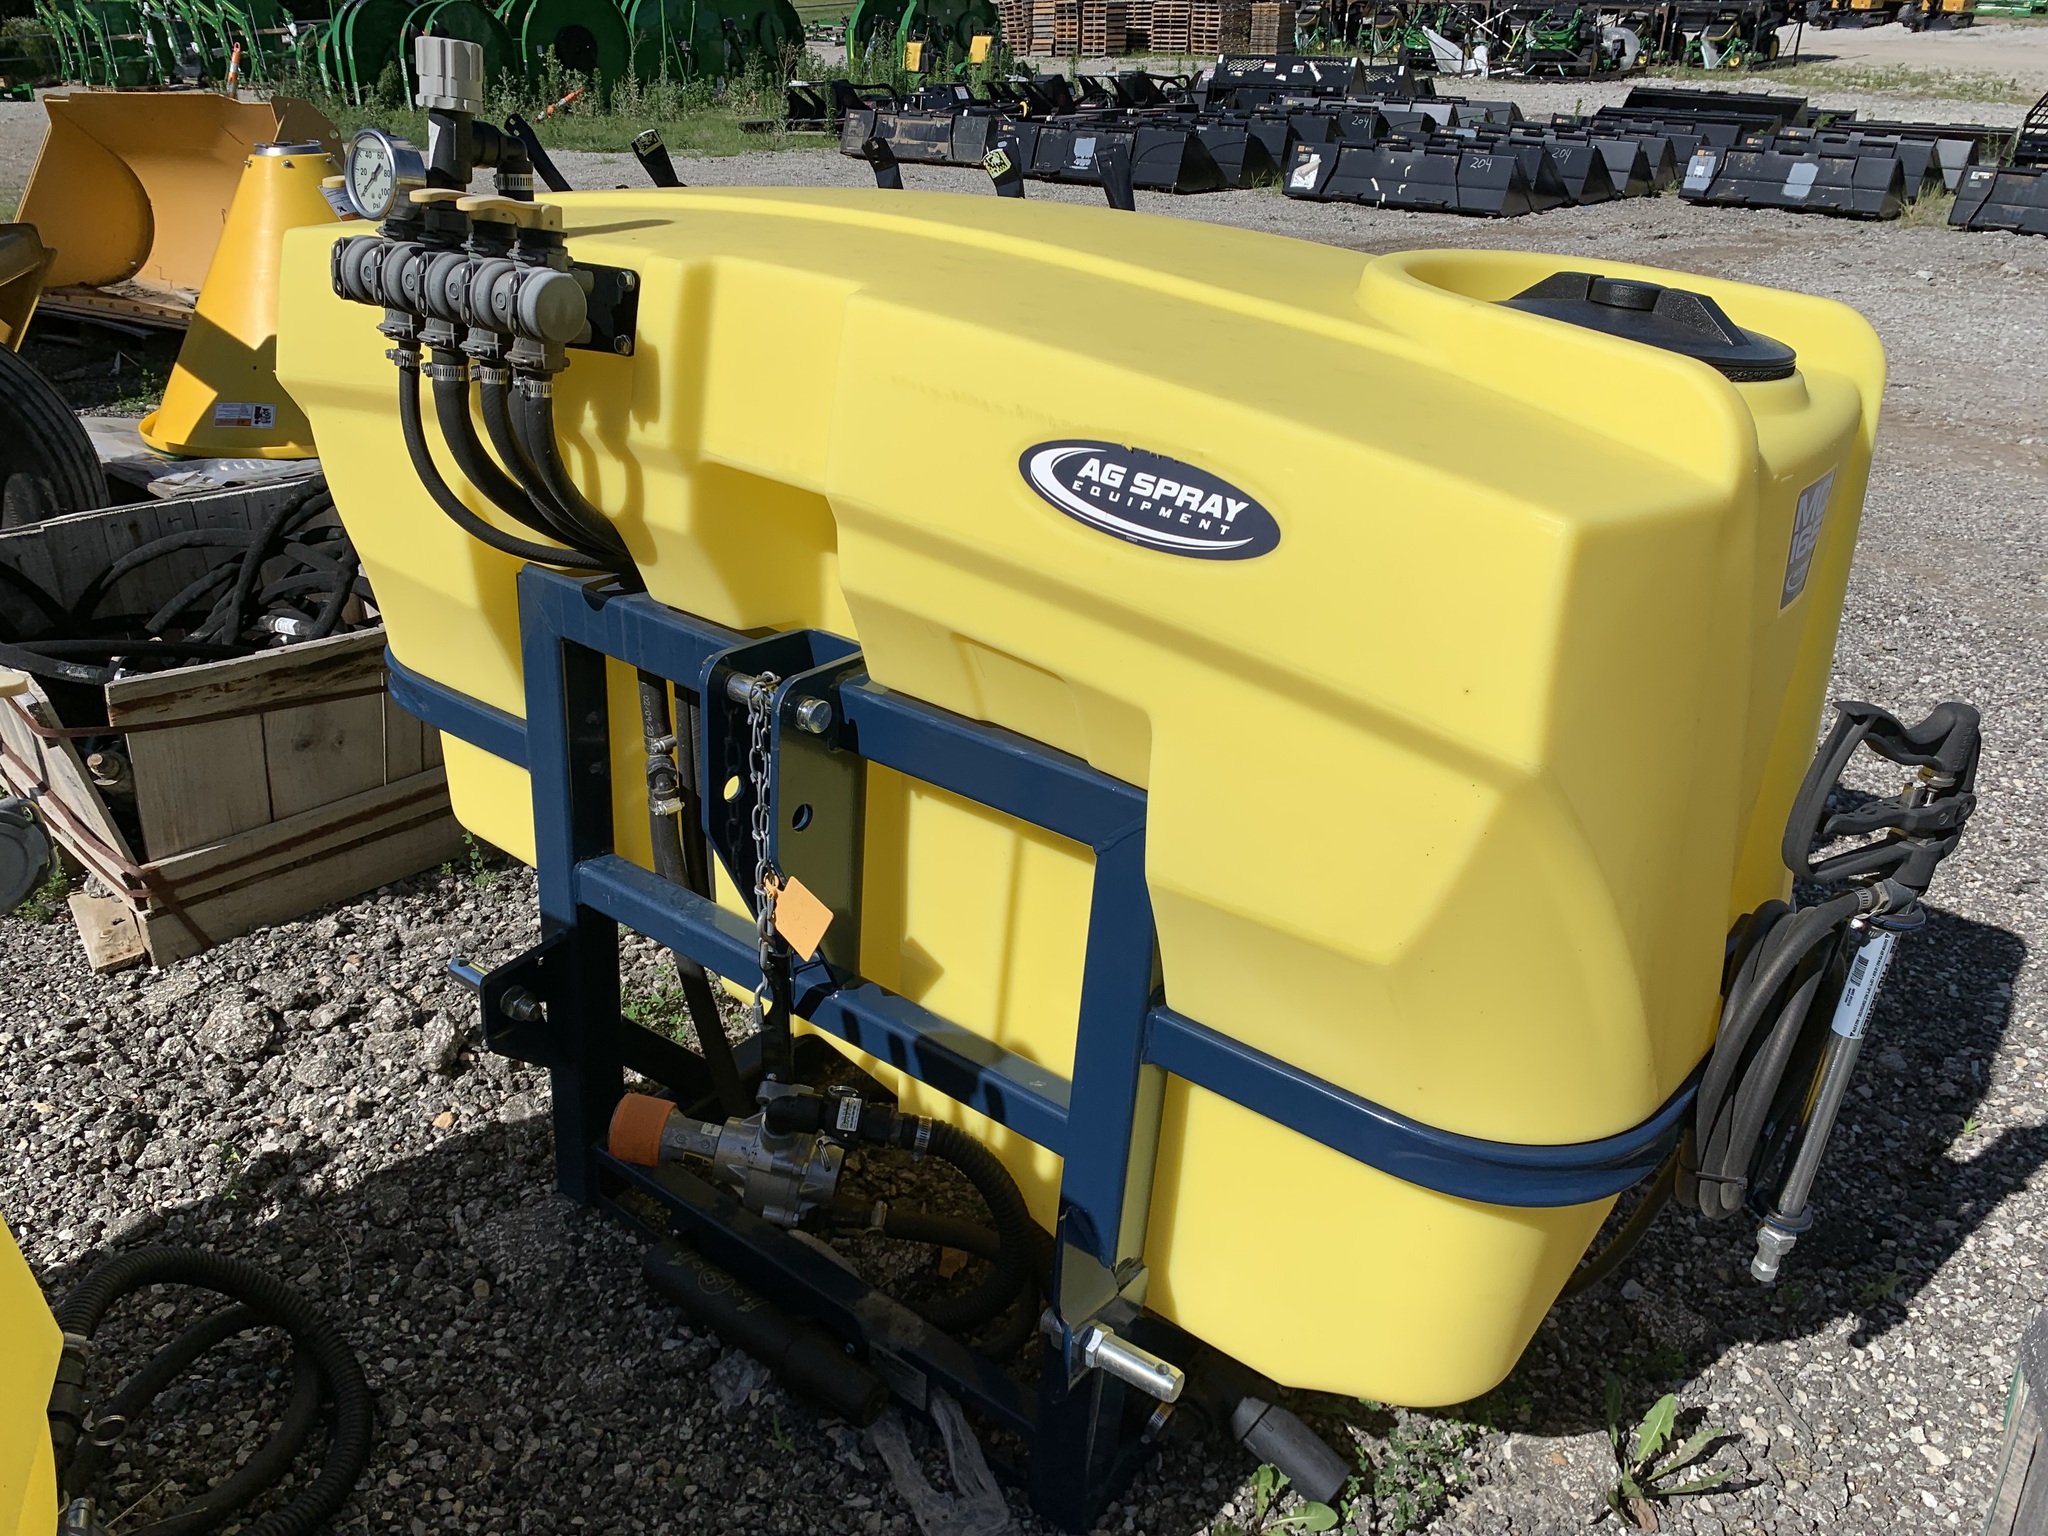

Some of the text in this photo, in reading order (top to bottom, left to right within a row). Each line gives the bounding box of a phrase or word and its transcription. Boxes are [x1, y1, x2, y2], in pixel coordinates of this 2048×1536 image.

[1351, 116, 1370, 128] 204
[365, 151, 372, 159] 40
[377, 152, 384, 160] 60
[1552, 147, 1573, 163] 204
[1470, 157, 1493, 172] 204
[361, 167, 367, 176] 20
[384, 169, 391, 178] 80
[373, 202, 381, 210] psi
[1077, 458, 1249, 523] AG SPRAY
[1071, 480, 1231, 535] EQUIPMENT
